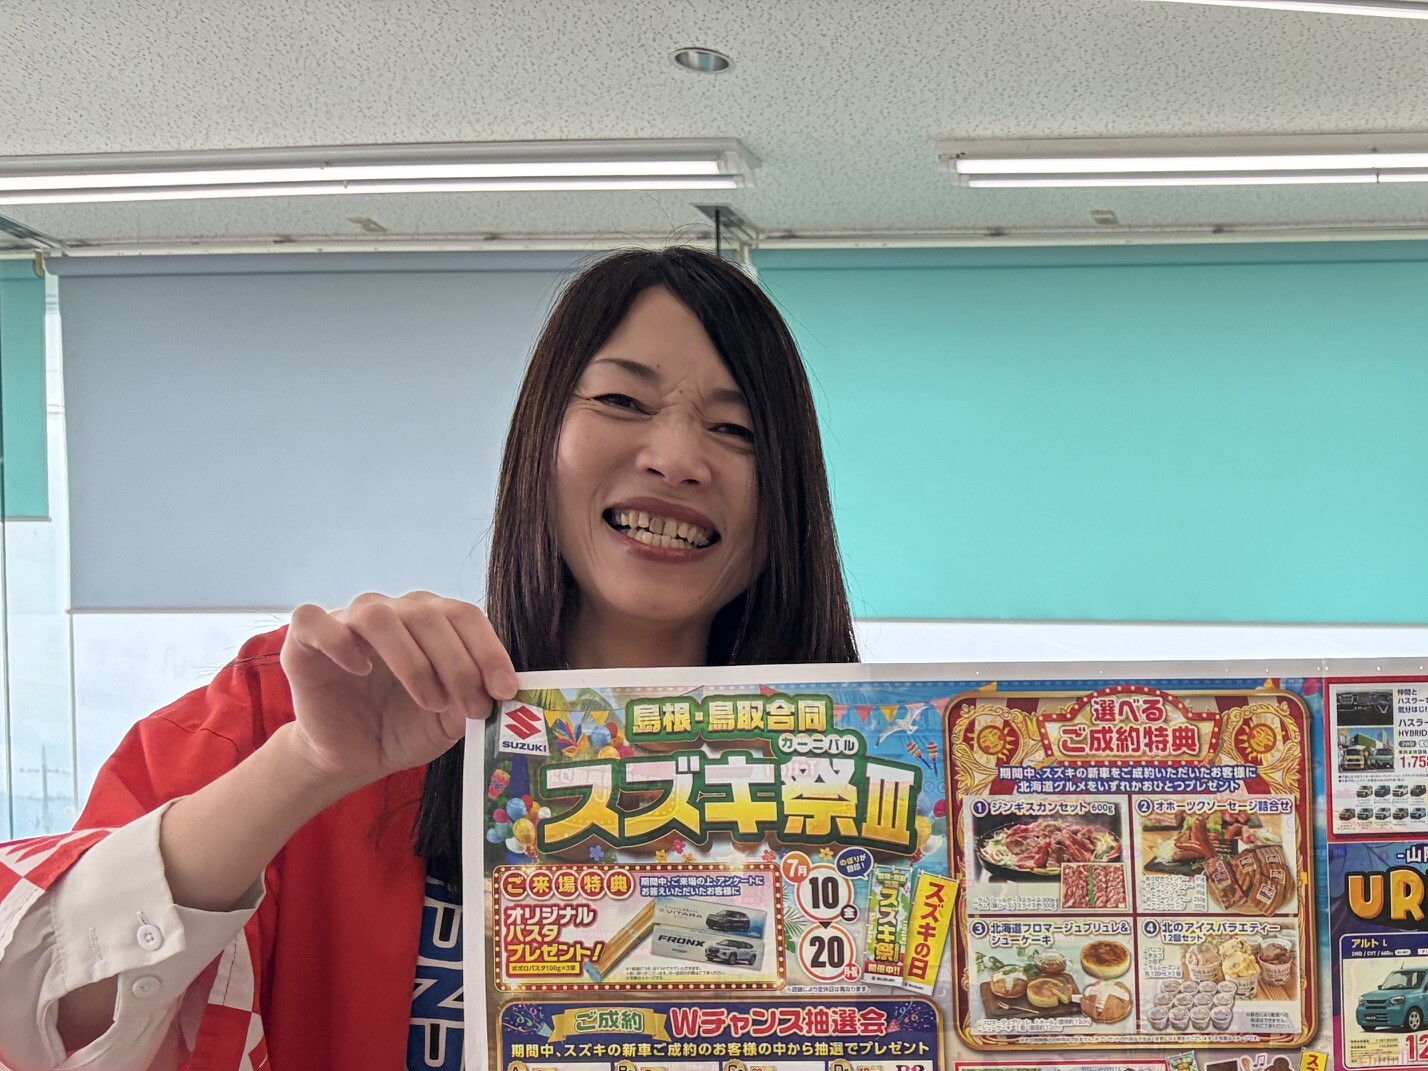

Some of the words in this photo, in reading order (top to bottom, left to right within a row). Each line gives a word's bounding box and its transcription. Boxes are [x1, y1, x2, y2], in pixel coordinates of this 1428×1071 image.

[1397, 688, 1417, 696] 仲間と
[632, 700, 827, 734] 島根・鳥取合同
[1091, 698, 1166, 723] 選べる
[502, 740, 548, 752] SUZUKI
[781, 735, 858, 754] カーニバル
[1059, 725, 1200, 756] ご成約特典
[999, 766, 1257, 780] 期間中、スズキの新車をご成約いただいたお客様に
[1018, 779, 1241, 794] 北海道グルメをいずれかおひとつプレゼント
[990, 801, 1089, 816] ジンギスカンセット
[1091, 803, 1115, 816] 600g
[1155, 800, 1292, 814] オホーツクソーセージ詰合せ
[787, 858, 808, 878] 7月
[507, 874, 629, 895] ご来場特典
[642, 886, 741, 897] お答えいただいたお客様に
[809, 876, 840, 909] 10
[506, 906, 595, 926] オリジナル
[665, 909, 703, 919] VITARA
[506, 925, 560, 943] パスタ
[908, 881, 945, 980] スズキの日
[1161, 921, 1281, 934] 北のアイスバラエティー
[658, 934, 705, 948] FRONX
[990, 935, 1053, 948] シューケーキ
[1162, 933, 1204, 943] 12個セット
[1352, 939, 1379, 948] アルト
[809, 935, 845, 968] 20
[574, 1011, 644, 1032] ご成約
[670, 1008, 888, 1037] Wチャンス抽選会
[511, 1042, 930, 1059] 期間中、スズキの新車ご成約のお客様の中から抽選でプレゼント
